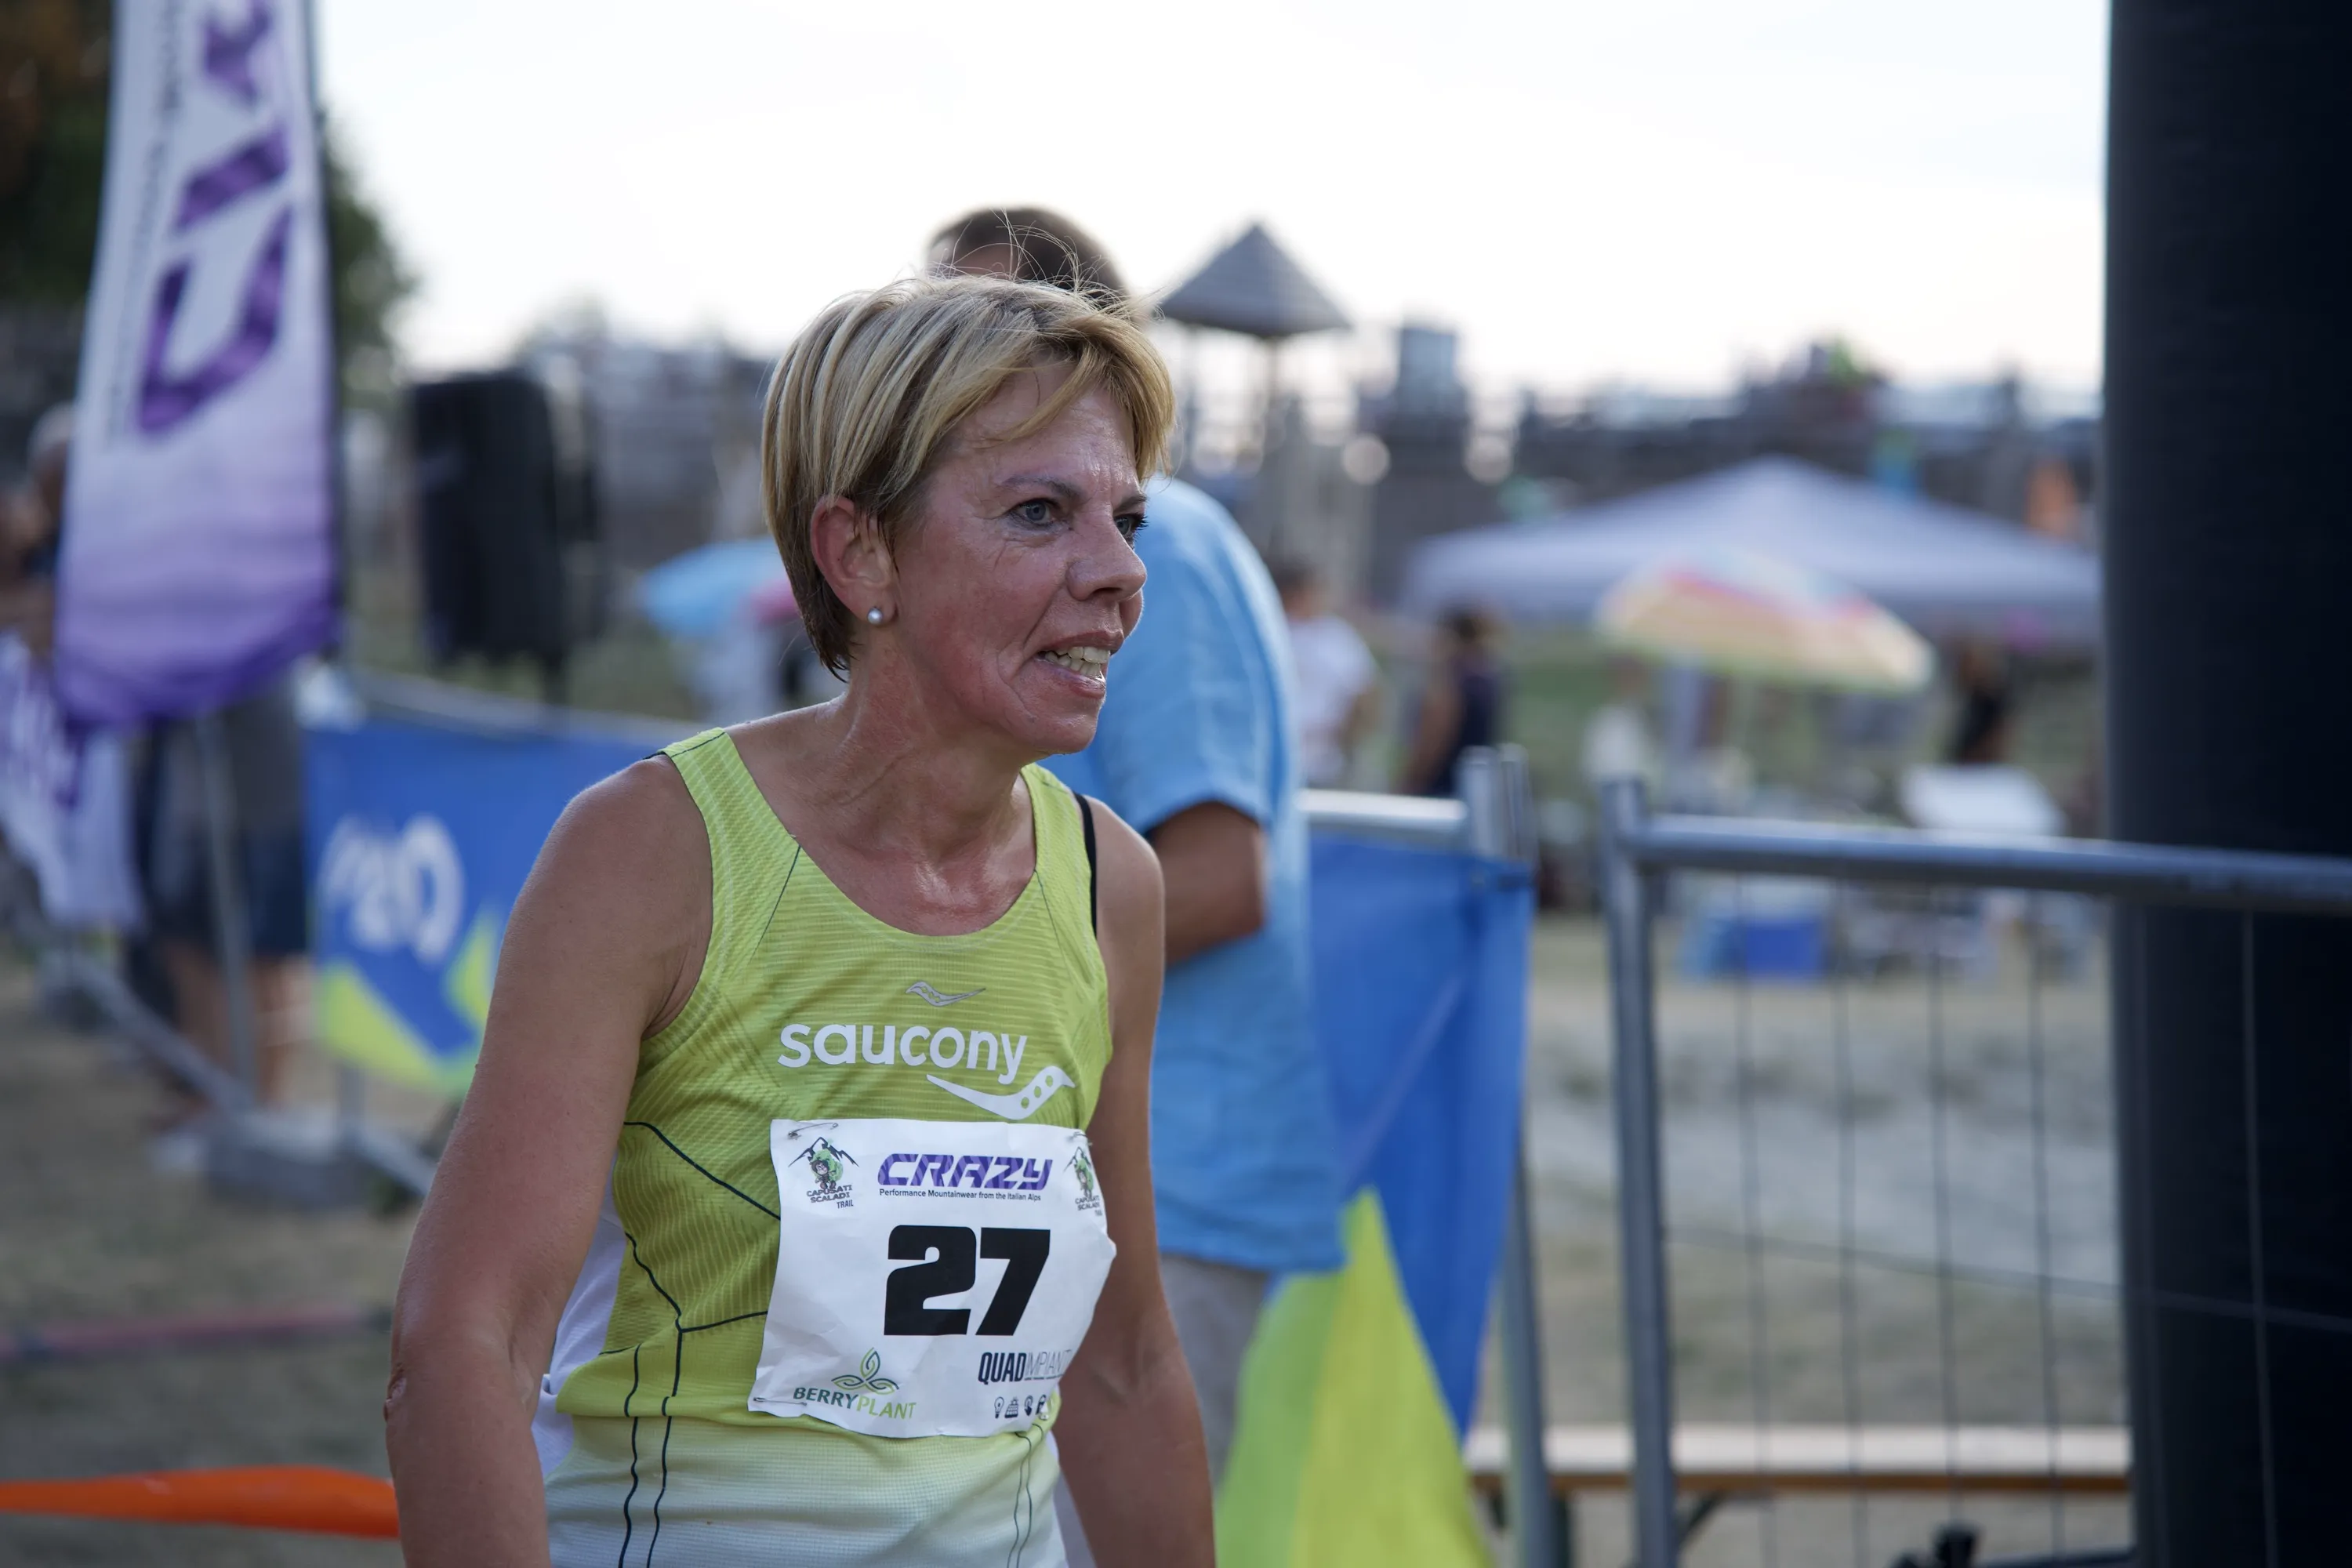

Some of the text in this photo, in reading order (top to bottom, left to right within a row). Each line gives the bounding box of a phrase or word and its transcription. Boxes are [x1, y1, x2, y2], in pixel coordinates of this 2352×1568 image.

[777, 1023, 1028, 1085] saucony
[877, 1153, 1053, 1191] CRAZY
[810, 1192, 851, 1203] SCALADI
[836, 1199, 854, 1209] TRAIL
[879, 1189, 927, 1198] Performance
[927, 1190, 978, 1200] Mountainwear
[996, 1192, 1007, 1200] the
[1007, 1192, 1027, 1201] Italian
[1028, 1193, 1042, 1202] Alps
[884, 1225, 1051, 1336] 27
